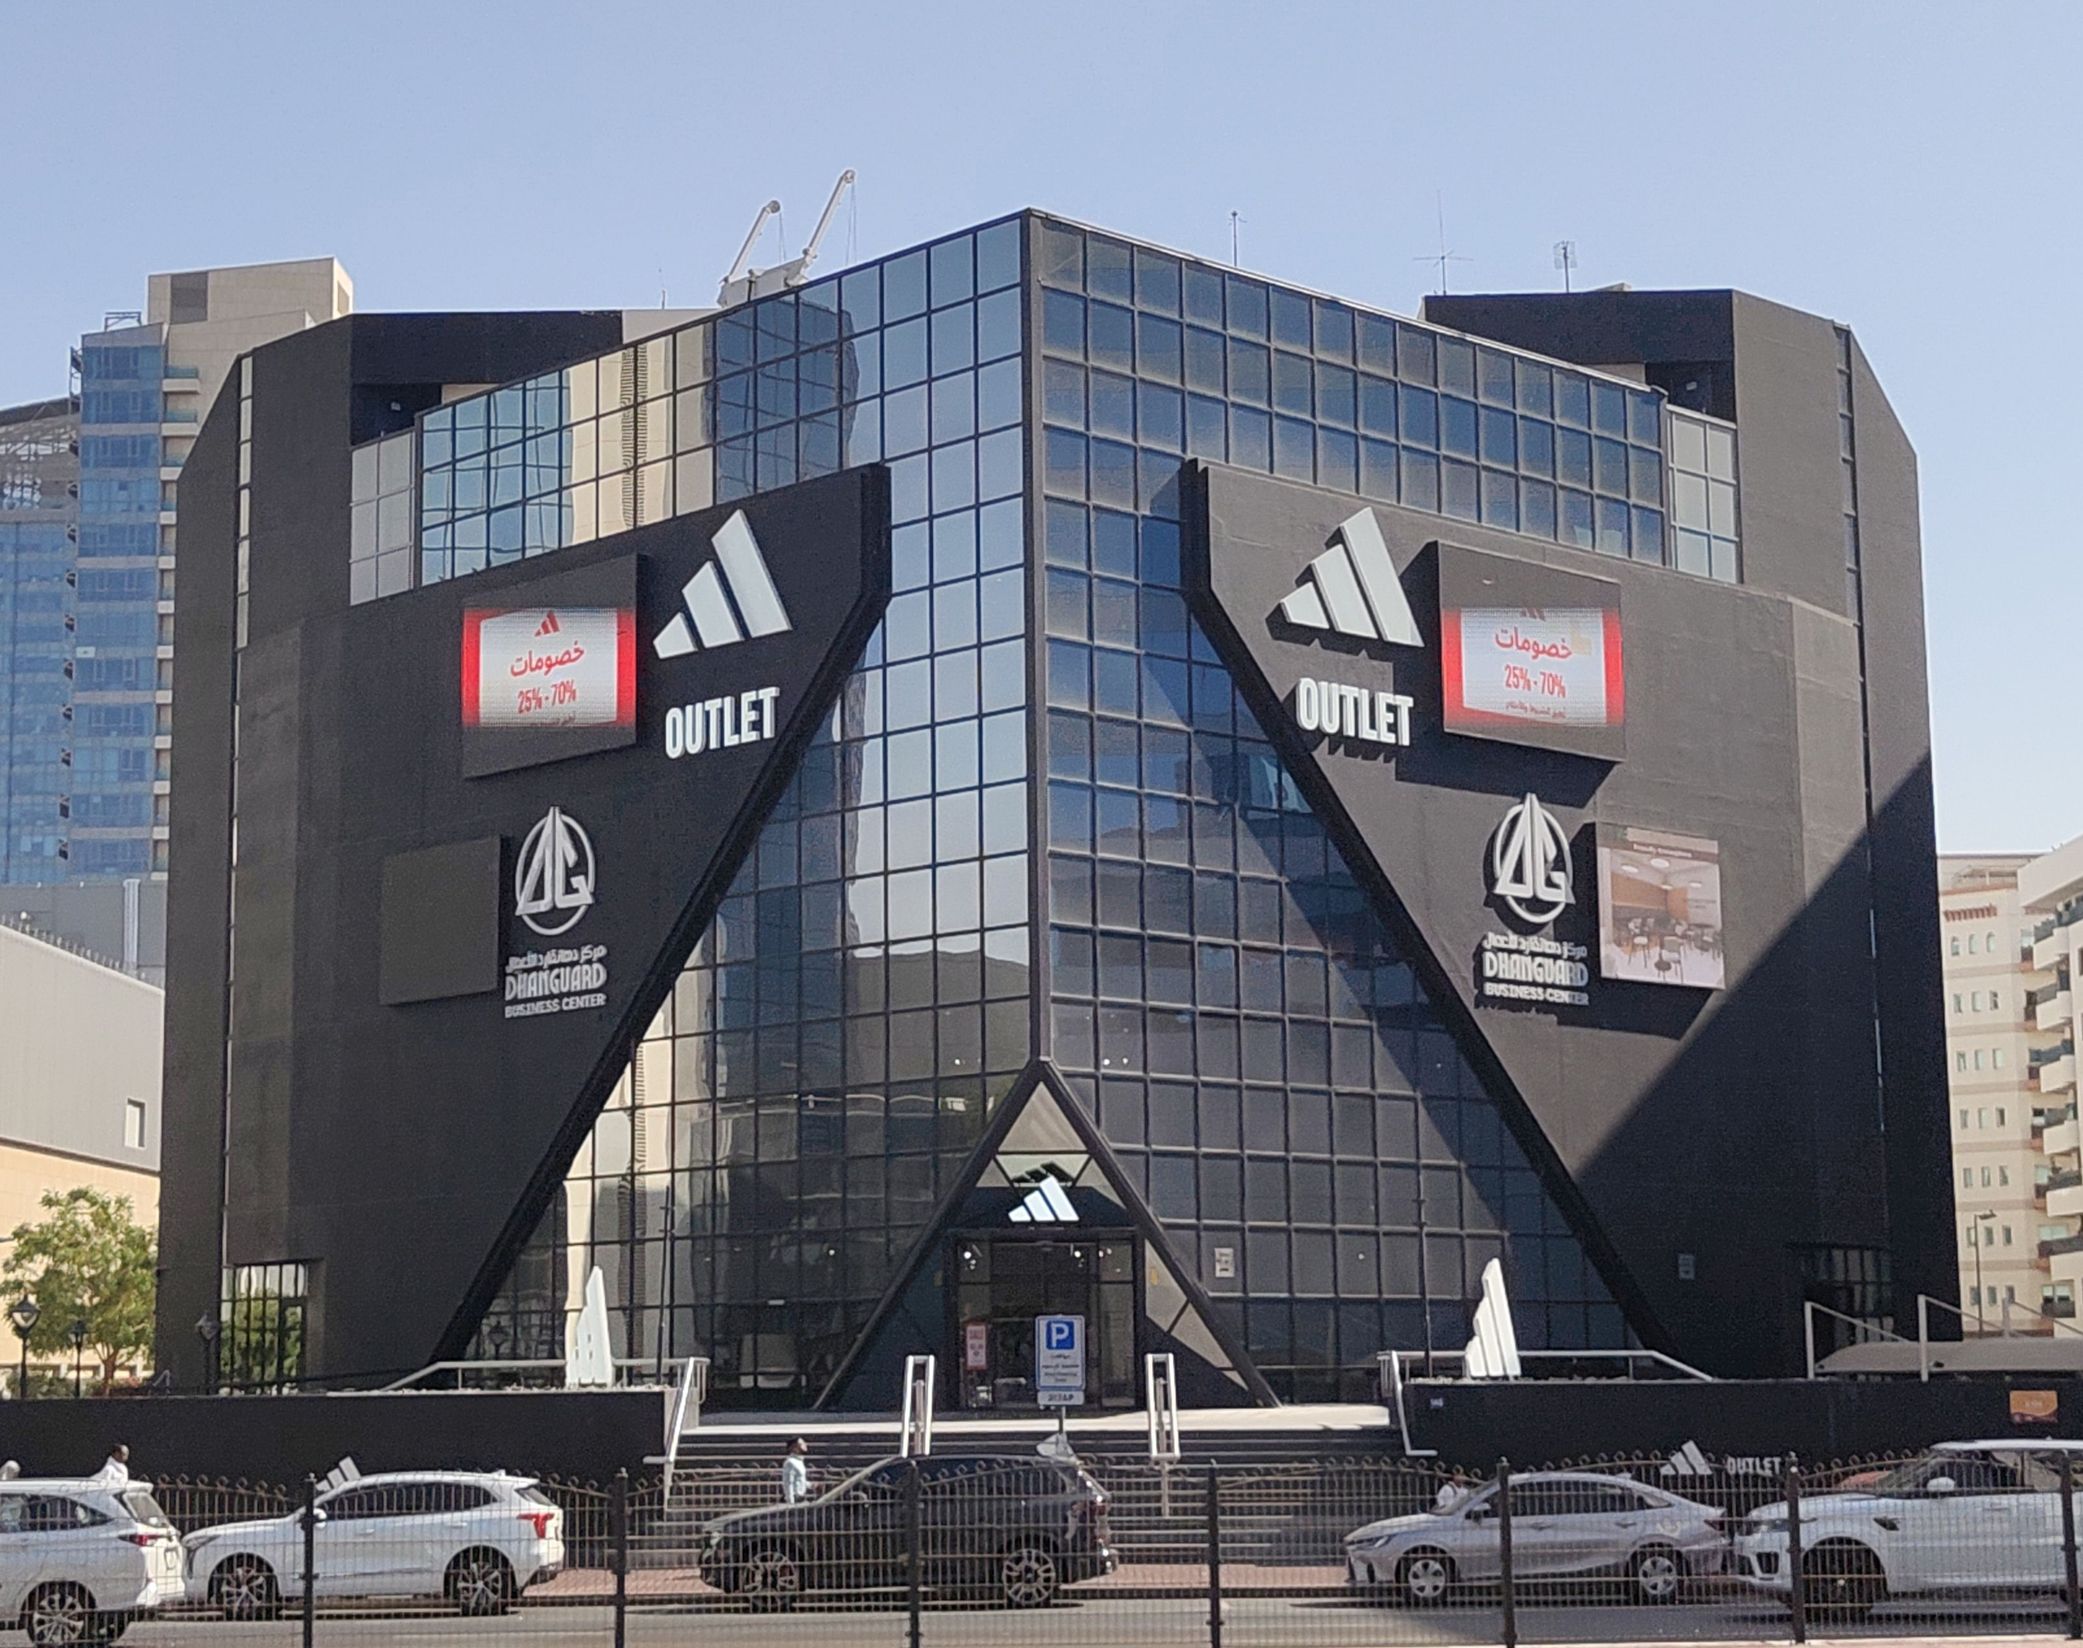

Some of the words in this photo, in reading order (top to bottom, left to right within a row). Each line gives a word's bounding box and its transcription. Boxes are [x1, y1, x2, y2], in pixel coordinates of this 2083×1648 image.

[510, 640, 585, 677] خصومات
[1495, 626, 1573, 660] خصومات
[665, 686, 780, 759] OUTLET
[1296, 677, 1414, 746] OUTLET
[504, 962, 608, 1001] DHANGUARD
[1482, 951, 1589, 987] DHANGUARD
[504, 999, 561, 1019] BUSINESS
[561, 993, 607, 1011] CENTER
[1483, 982, 1545, 1001] BUSINESS
[1545, 988, 1589, 1006] CENTER
[1050, 1322, 1070, 1348] P
[1726, 1456, 1781, 1476] OUTLET
